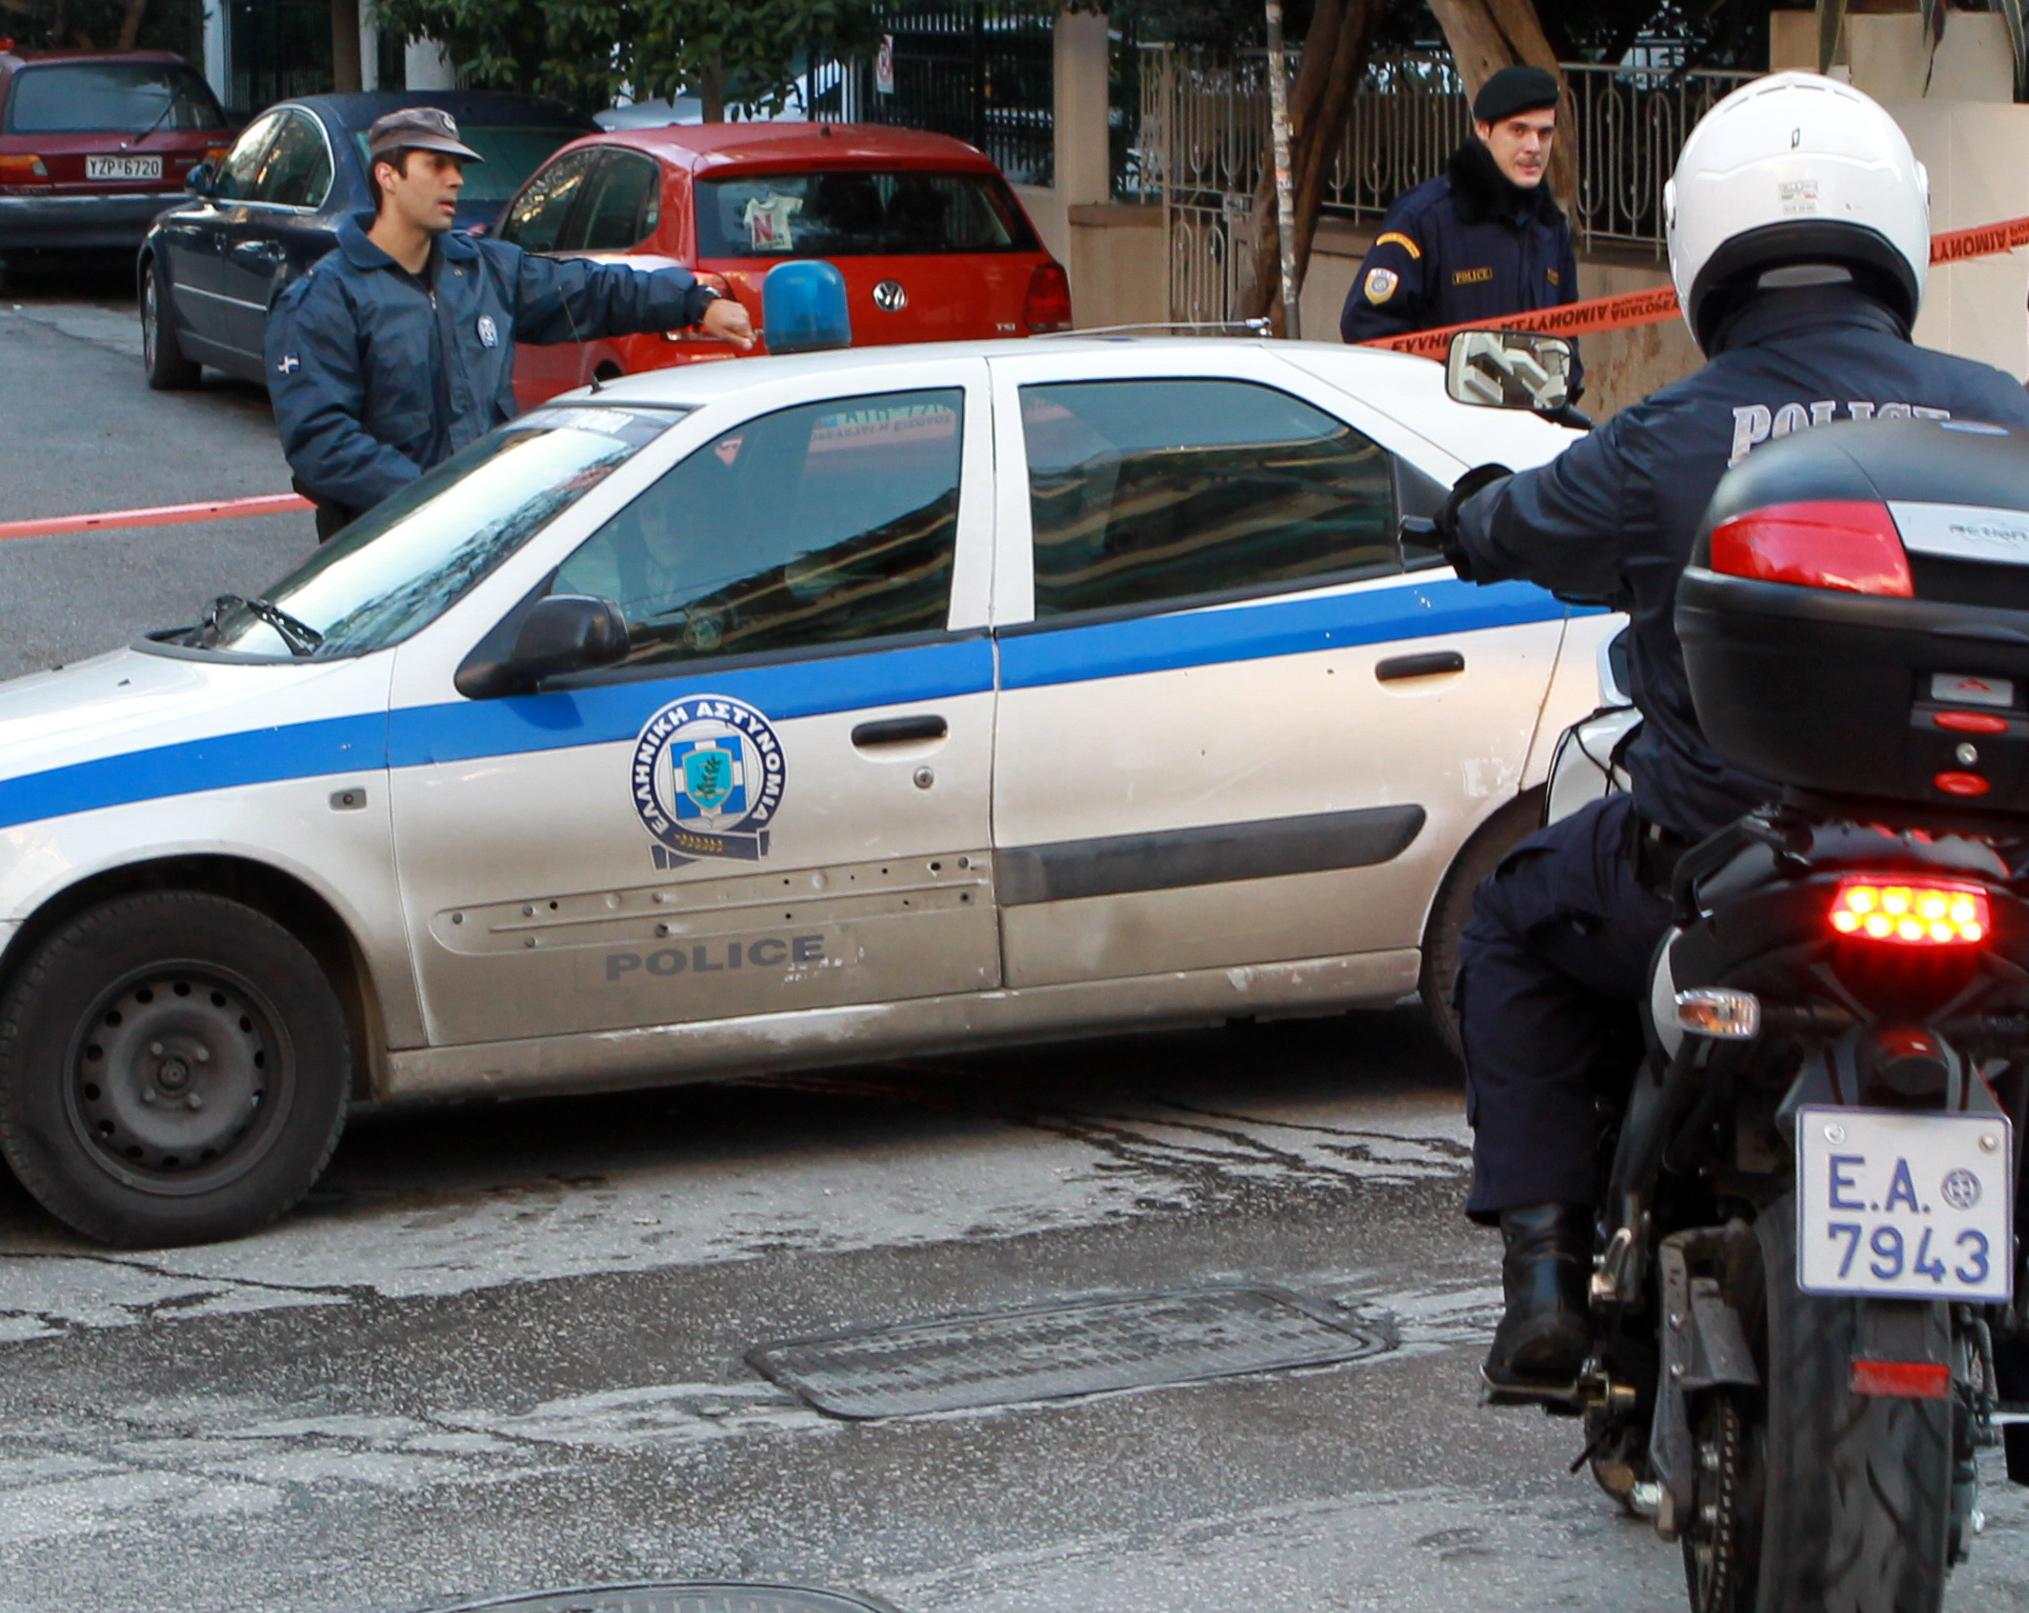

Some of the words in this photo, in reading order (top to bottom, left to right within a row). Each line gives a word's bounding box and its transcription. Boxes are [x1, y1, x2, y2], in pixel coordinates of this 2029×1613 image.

[634, 706, 690, 836] ΕΛΛΗΝΙΚΗ
[696, 701, 782, 821] ΑΣΤΥΝΟΜΙΑ
[605, 934, 825, 982] POLICE
[1828, 1153, 1931, 1213] E.A.
[1828, 1222, 1990, 1285] 7943
